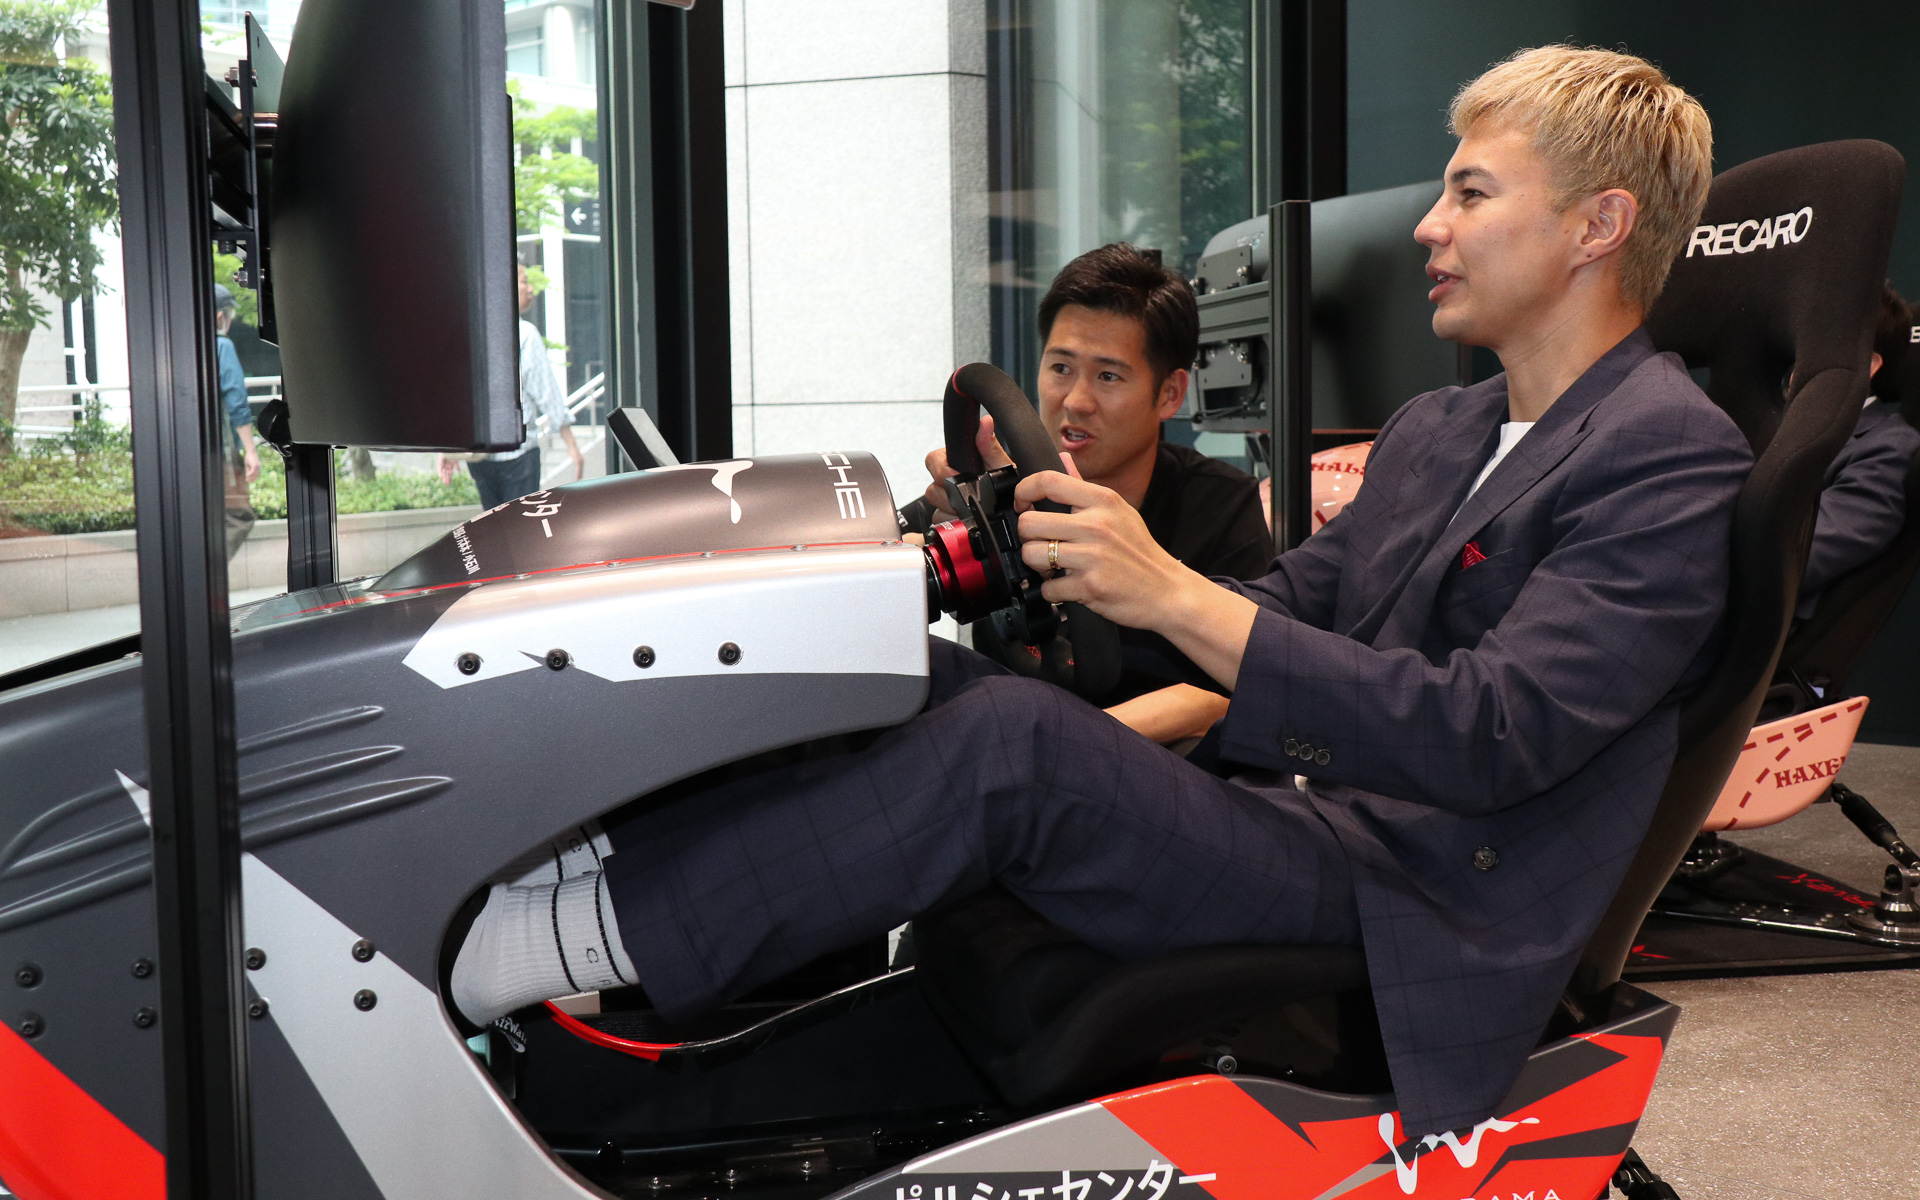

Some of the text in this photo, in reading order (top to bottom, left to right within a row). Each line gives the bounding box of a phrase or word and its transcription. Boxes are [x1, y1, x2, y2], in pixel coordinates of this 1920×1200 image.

[1686, 206, 1813, 258] RECARO
[1311, 462, 1364, 476] HAL
[519, 490, 562, 538] ンター
